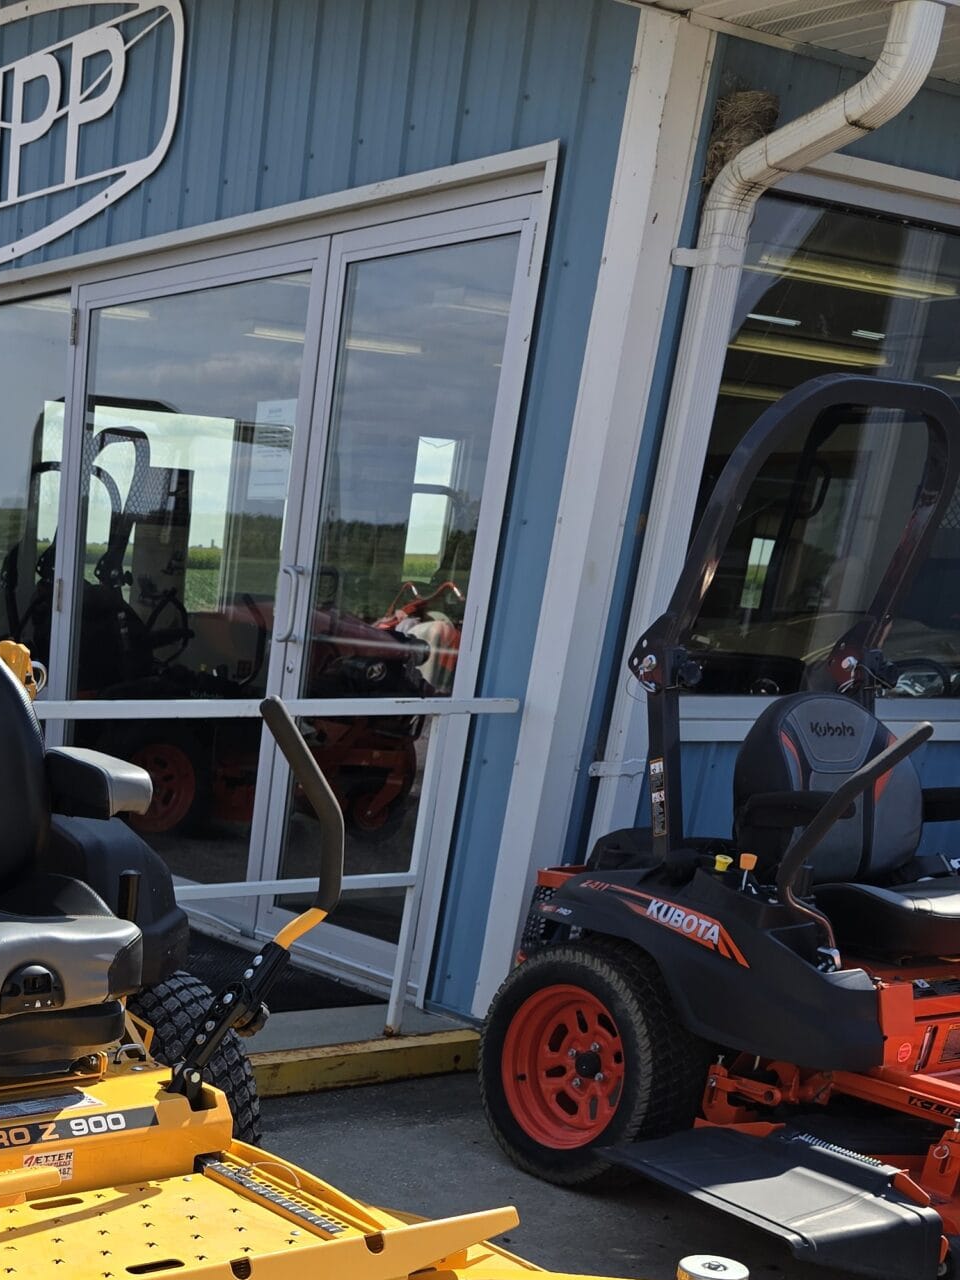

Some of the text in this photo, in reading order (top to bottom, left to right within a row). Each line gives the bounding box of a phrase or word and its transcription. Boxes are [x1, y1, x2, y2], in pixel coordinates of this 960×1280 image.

[810, 721, 855, 737] Kubota
[646, 898, 720, 945] KUBOTA
[39, 1122, 59, 1141] Z
[69, 1113, 126, 1136] 900
